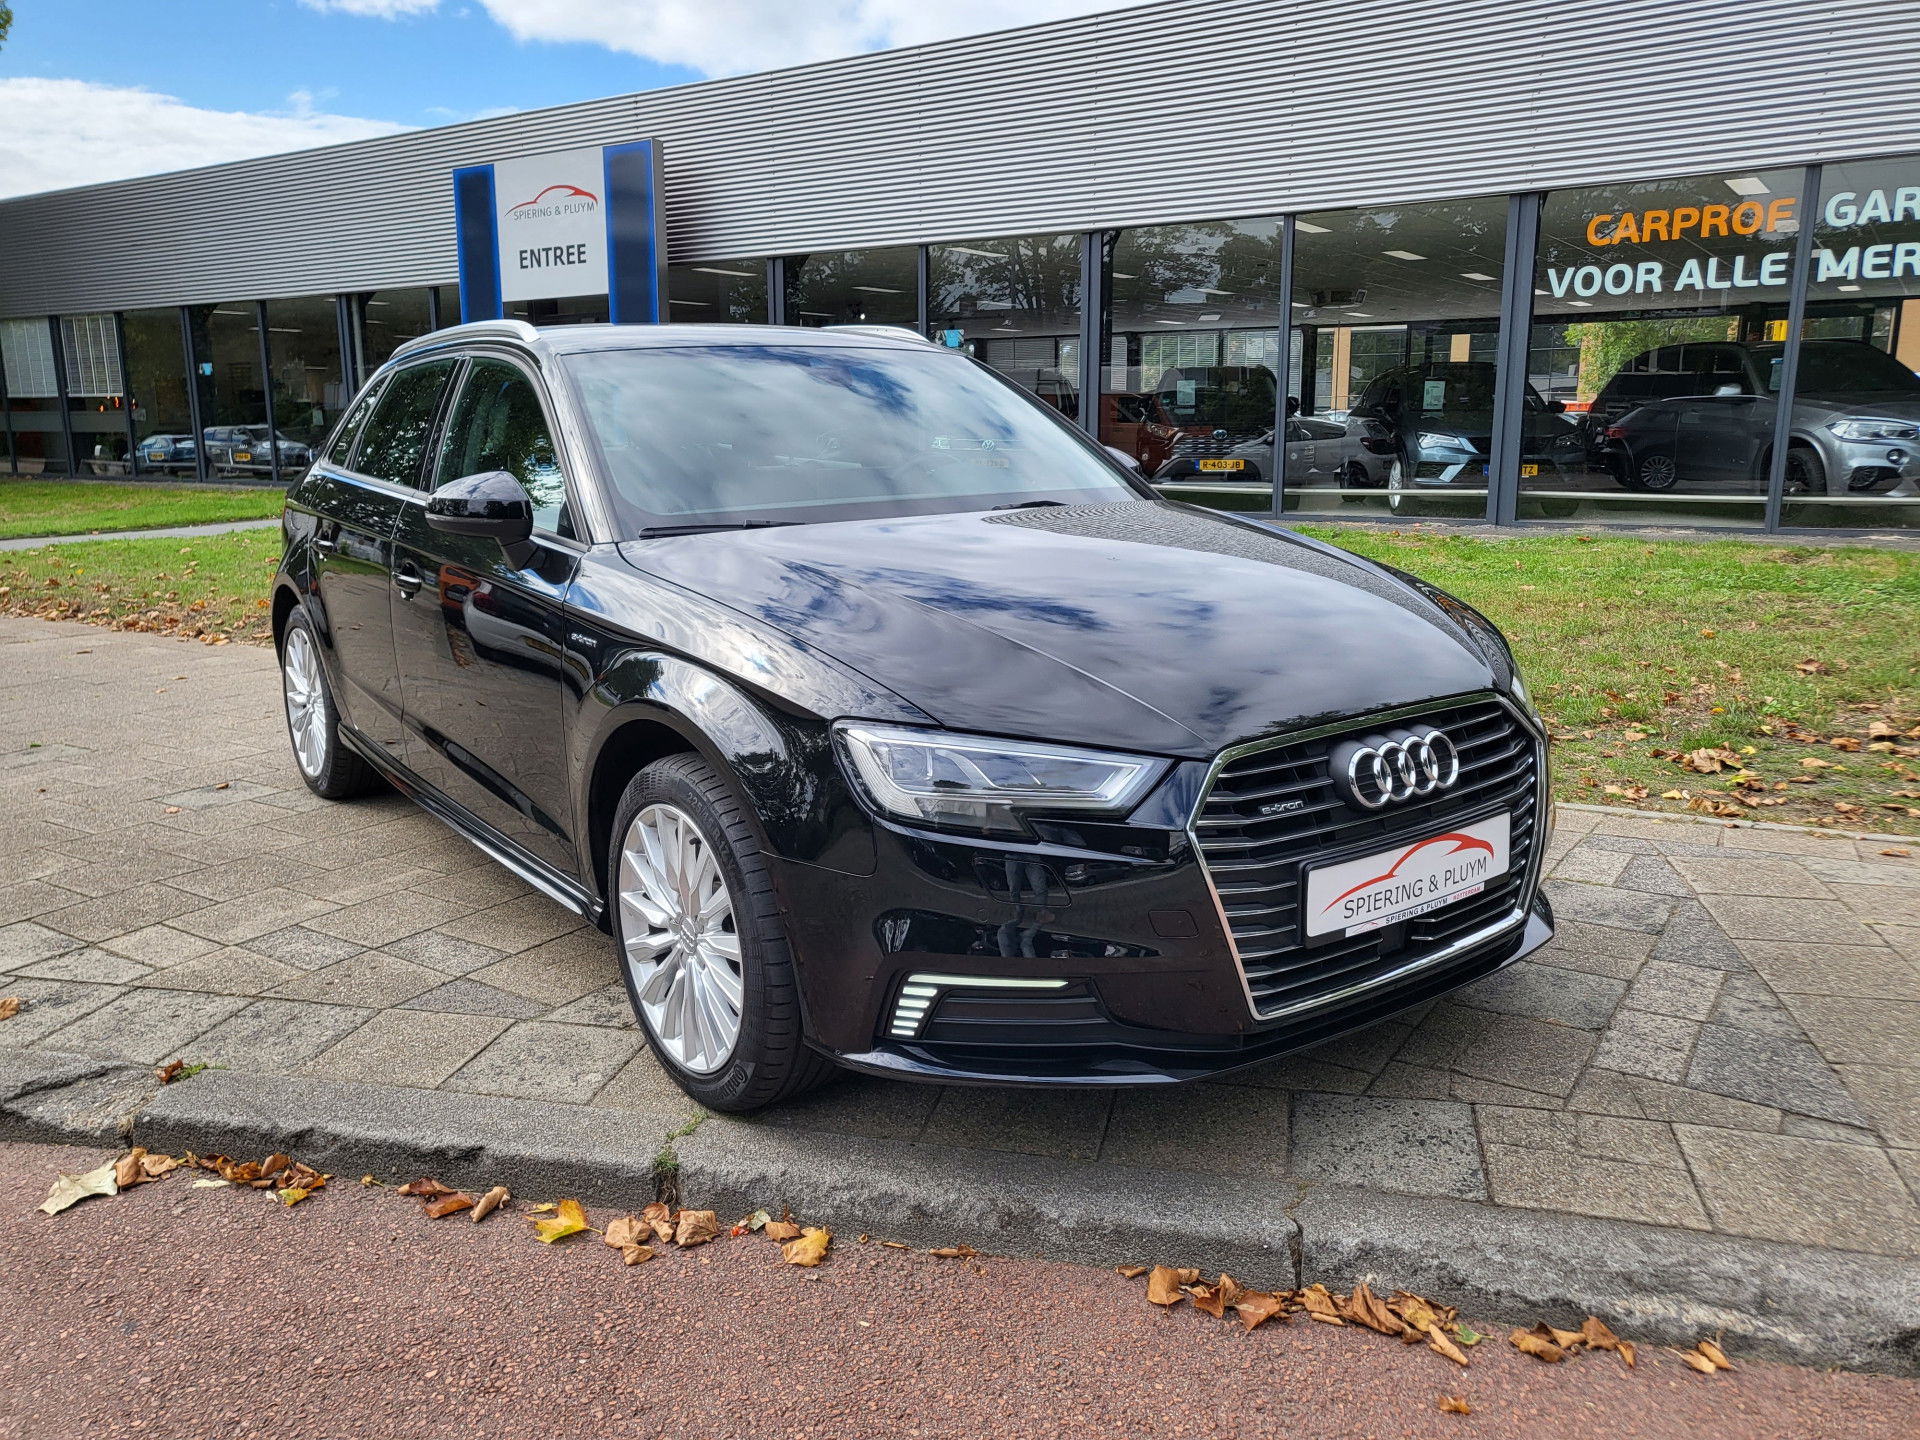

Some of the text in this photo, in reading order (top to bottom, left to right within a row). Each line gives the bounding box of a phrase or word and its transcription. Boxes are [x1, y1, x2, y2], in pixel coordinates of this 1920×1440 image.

[513, 202, 595, 221] SPIERING & PLUYM
[1586, 198, 1797, 246] CARPROF
[519, 243, 587, 270] ENTREE
[1547, 261, 1663, 298] VOOR
[1674, 252, 1790, 292] ALLE
[1202, 460, 1241, 469] R-403-JB
[1262, 800, 1304, 815] e-tron
[1343, 856, 1487, 919] SPIERING & PLUYM
[1385, 885, 1482, 924] SPIERING & PLUYM ROTTERDAM
